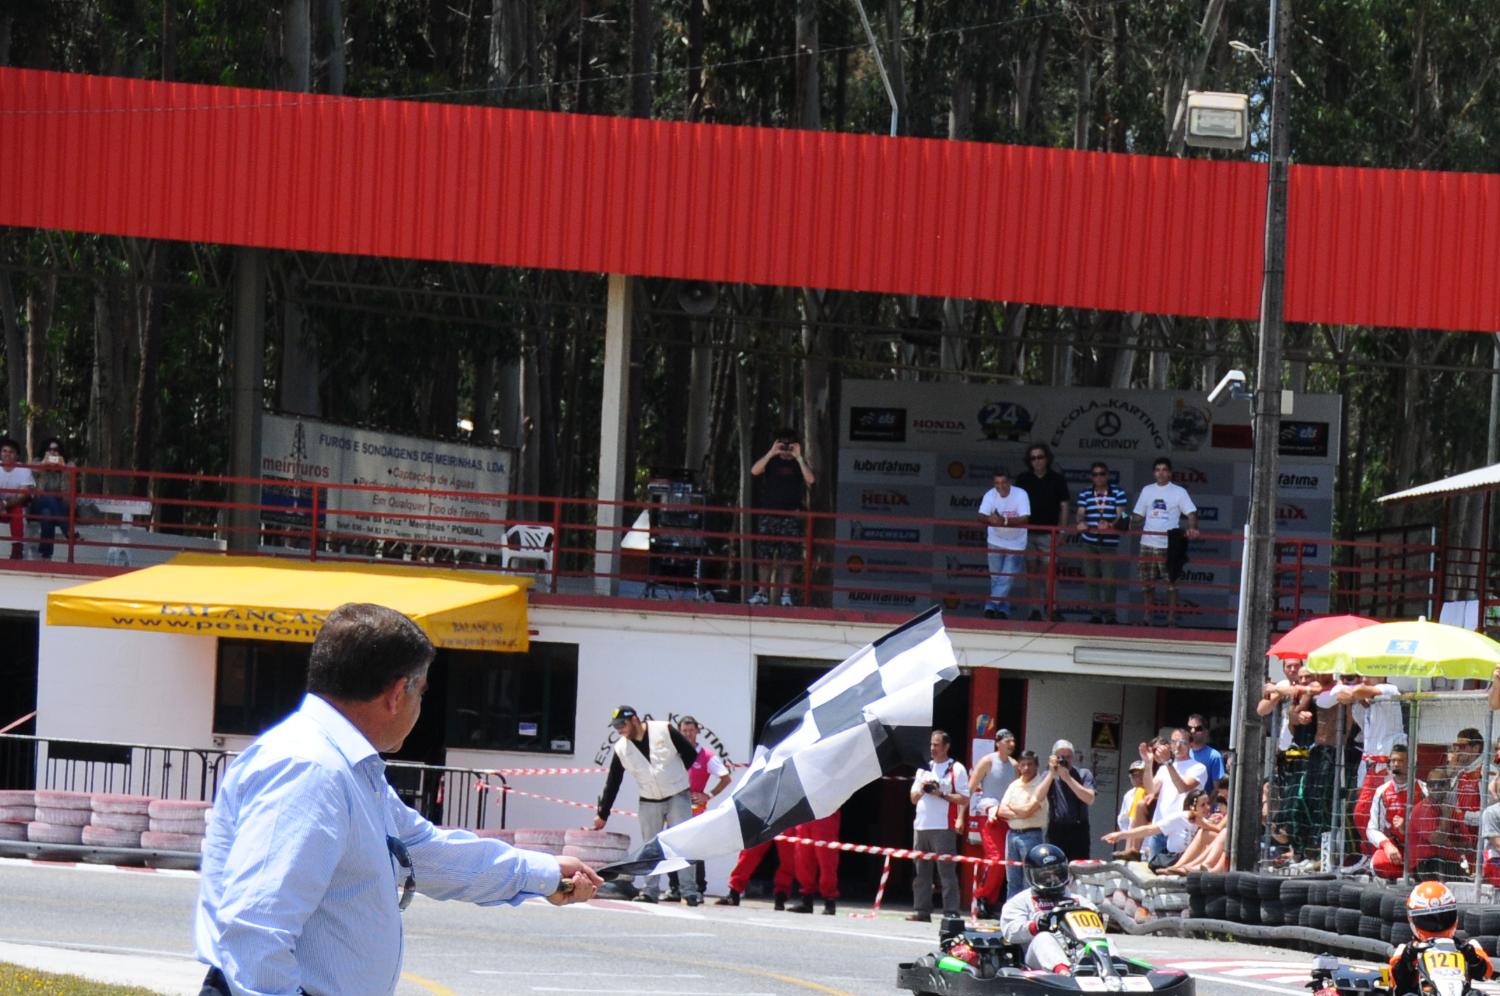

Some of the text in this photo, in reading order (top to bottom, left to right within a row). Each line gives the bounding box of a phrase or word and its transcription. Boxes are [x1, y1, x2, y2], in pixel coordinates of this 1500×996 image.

[985, 403, 1020, 424] 24
[913, 419, 967, 430] HONDA
[1051, 398, 1165, 449] ESCOLA KARTING
[319, 434, 352, 451] FUROS
[353, 441, 361, 453] E
[362, 443, 419, 461] SONDAGENS
[421, 452, 433, 463] DE
[1078, 438, 1140, 450] EUROINDY
[262, 455, 331, 479] meirifuros
[1173, 471, 1208, 483] ELIX
[861, 493, 910, 506] HELIX
[958, 529, 988, 542] HEL
[1071, 913, 1100, 929] 100
[1428, 952, 1460, 968] 127
